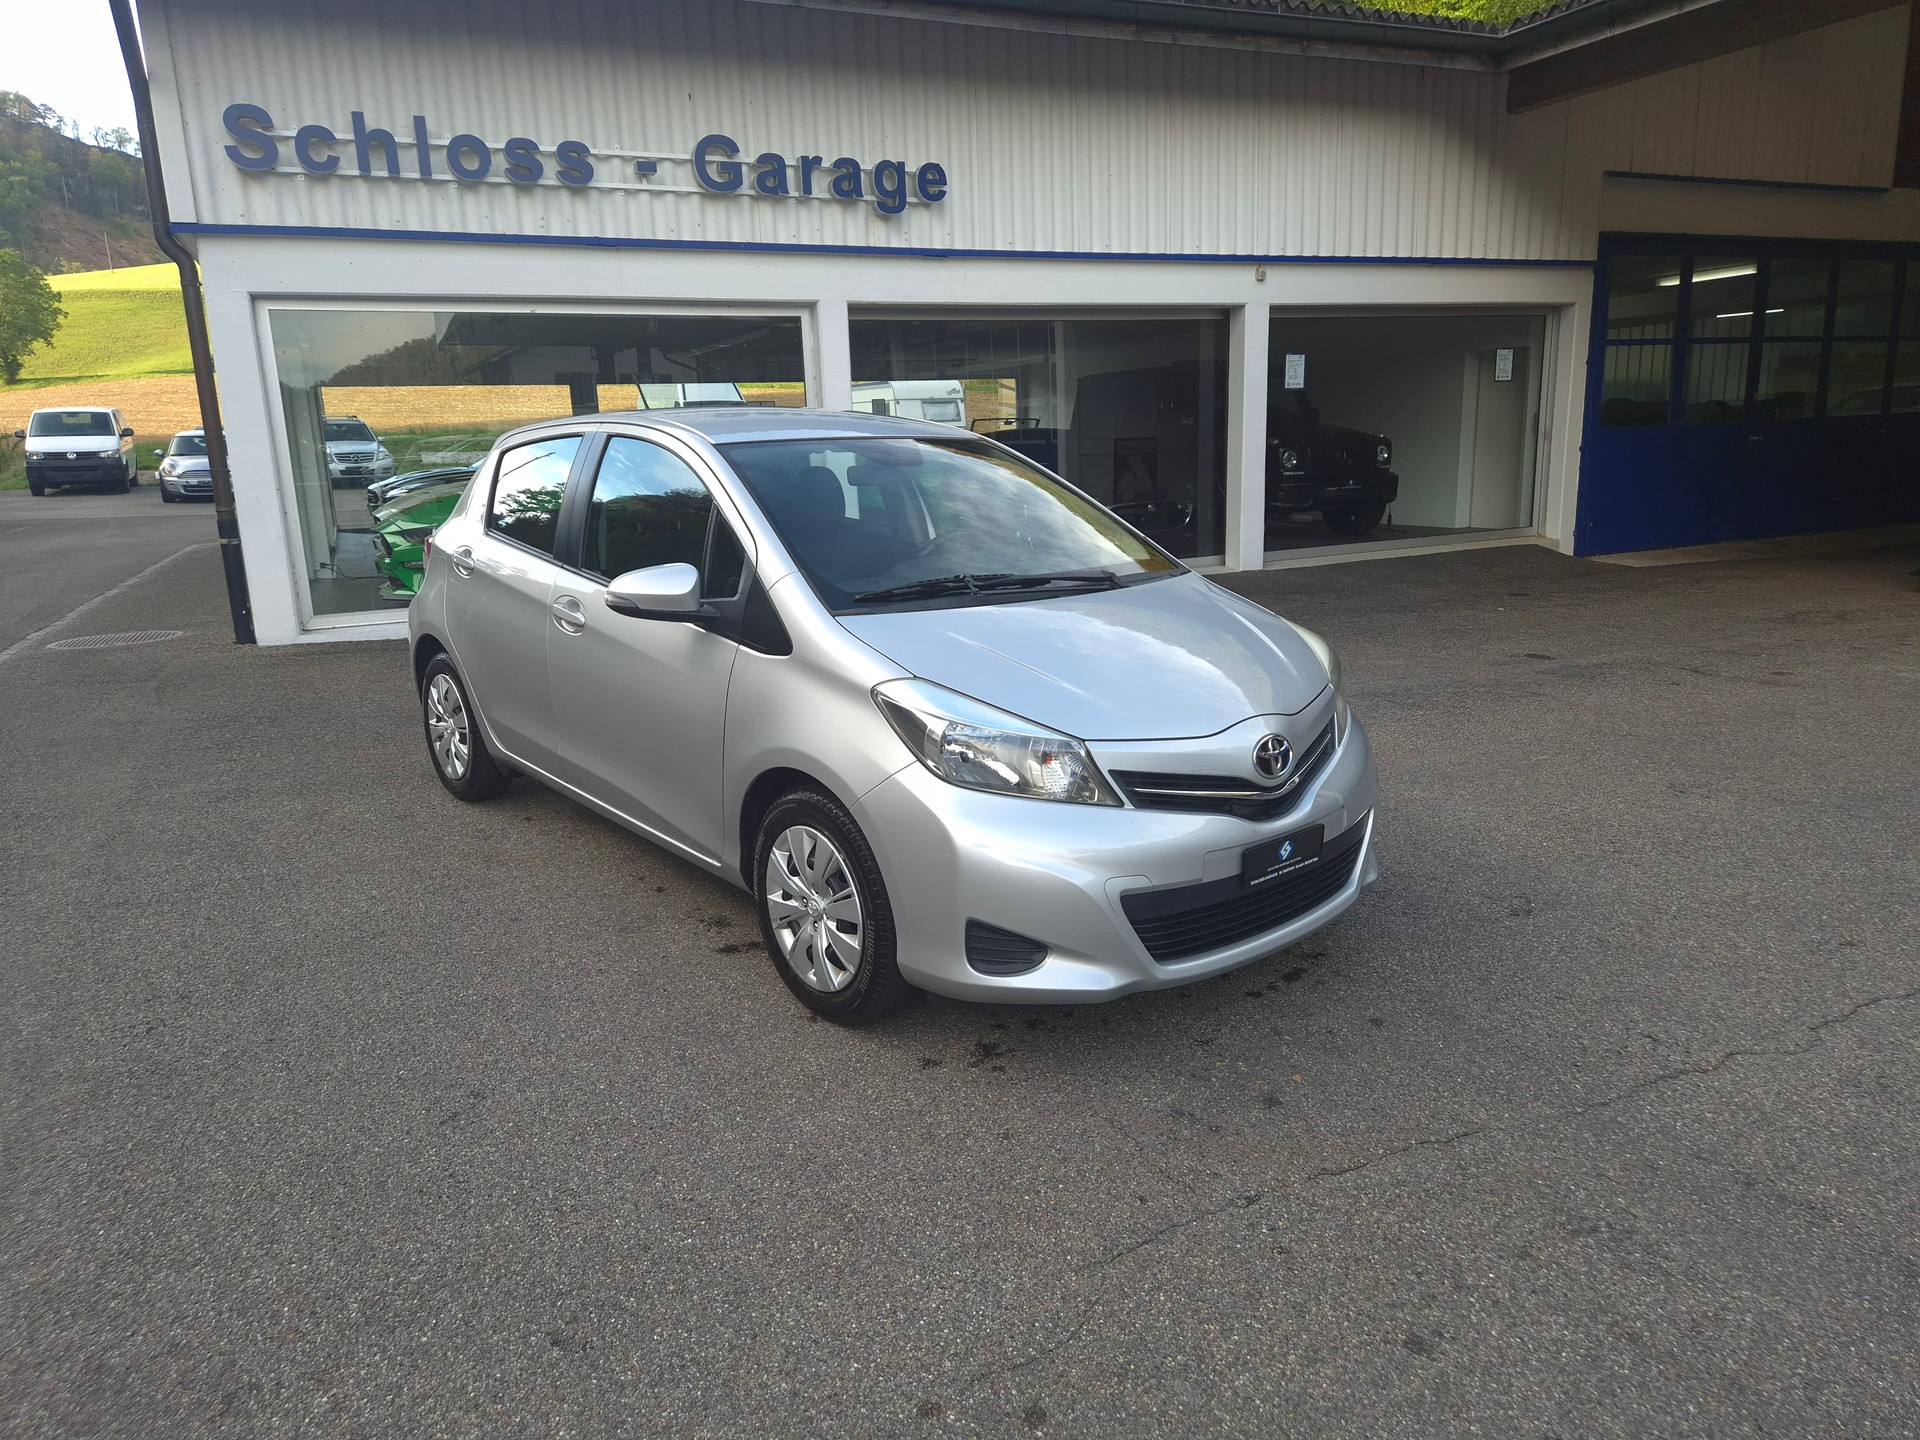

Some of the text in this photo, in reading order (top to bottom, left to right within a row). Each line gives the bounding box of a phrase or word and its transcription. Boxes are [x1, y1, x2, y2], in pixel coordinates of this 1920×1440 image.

[222, 102, 595, 187] Schloss
[692, 133, 948, 215] Garage
[860, 919, 875, 994] BRIDGESTONE
